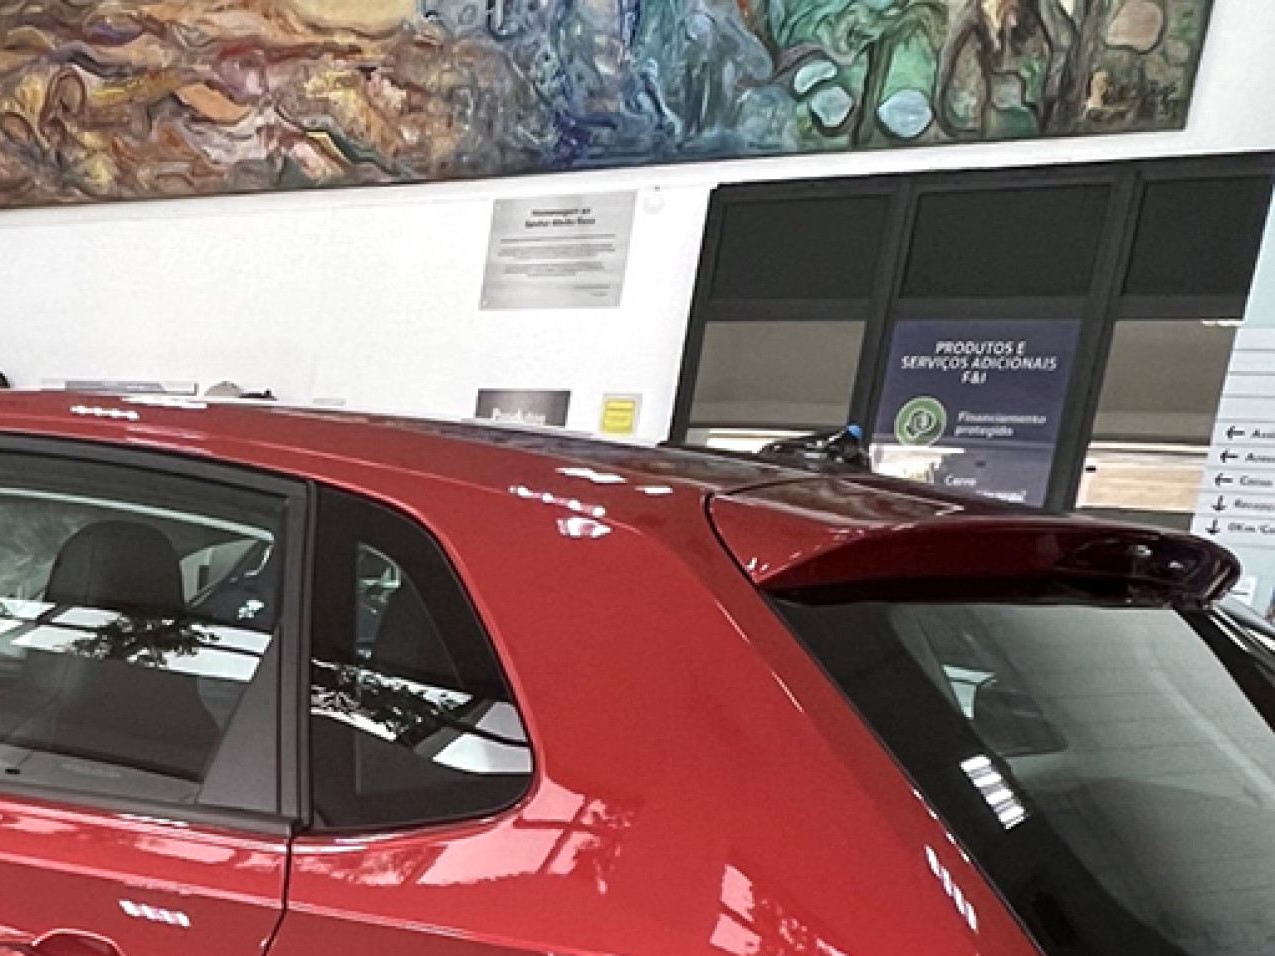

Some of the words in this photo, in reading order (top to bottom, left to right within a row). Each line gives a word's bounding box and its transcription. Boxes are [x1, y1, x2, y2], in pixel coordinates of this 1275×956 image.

[935, 340, 1014, 355] PRODUTOS
[1015, 341, 1026, 355] E
[901, 355, 969, 371] SERVIÇOS
[970, 356, 1057, 371] ADICIONAIS
[957, 411, 1047, 424] Financiamento
